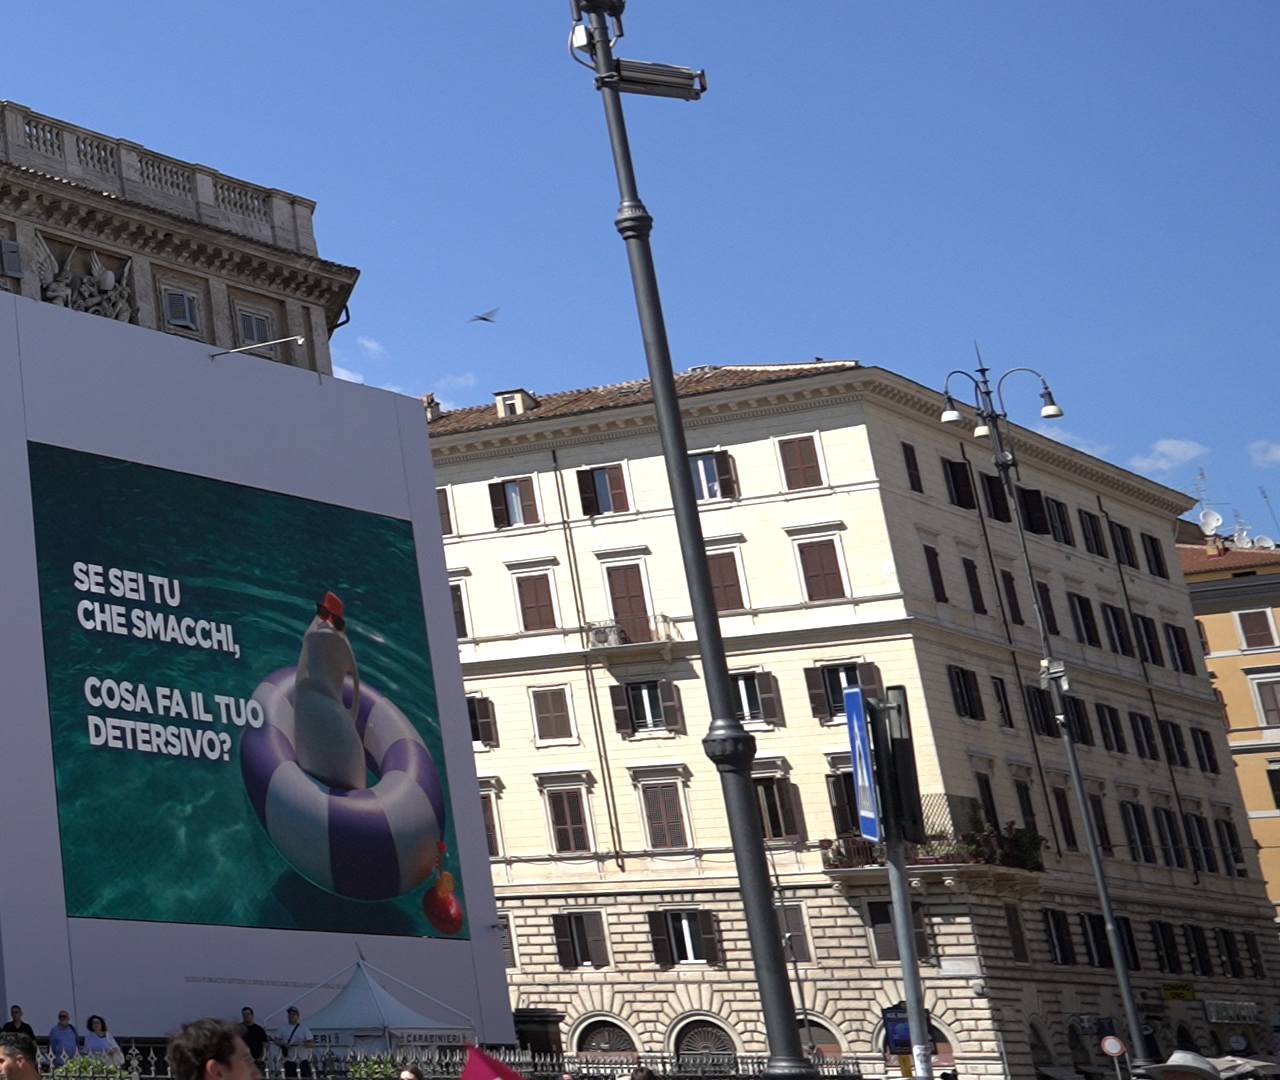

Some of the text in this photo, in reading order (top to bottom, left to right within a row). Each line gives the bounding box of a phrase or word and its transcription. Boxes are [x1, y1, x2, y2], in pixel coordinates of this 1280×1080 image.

[73, 561, 181, 607] SE SEI TU
[77, 599, 240, 659] CHE SMACCHI,
[85, 676, 264, 728] COSA FA IL TUO
[88, 715, 232, 761] DETERSIVO?
[406, 1032, 460, 1044] CARABINIERI
